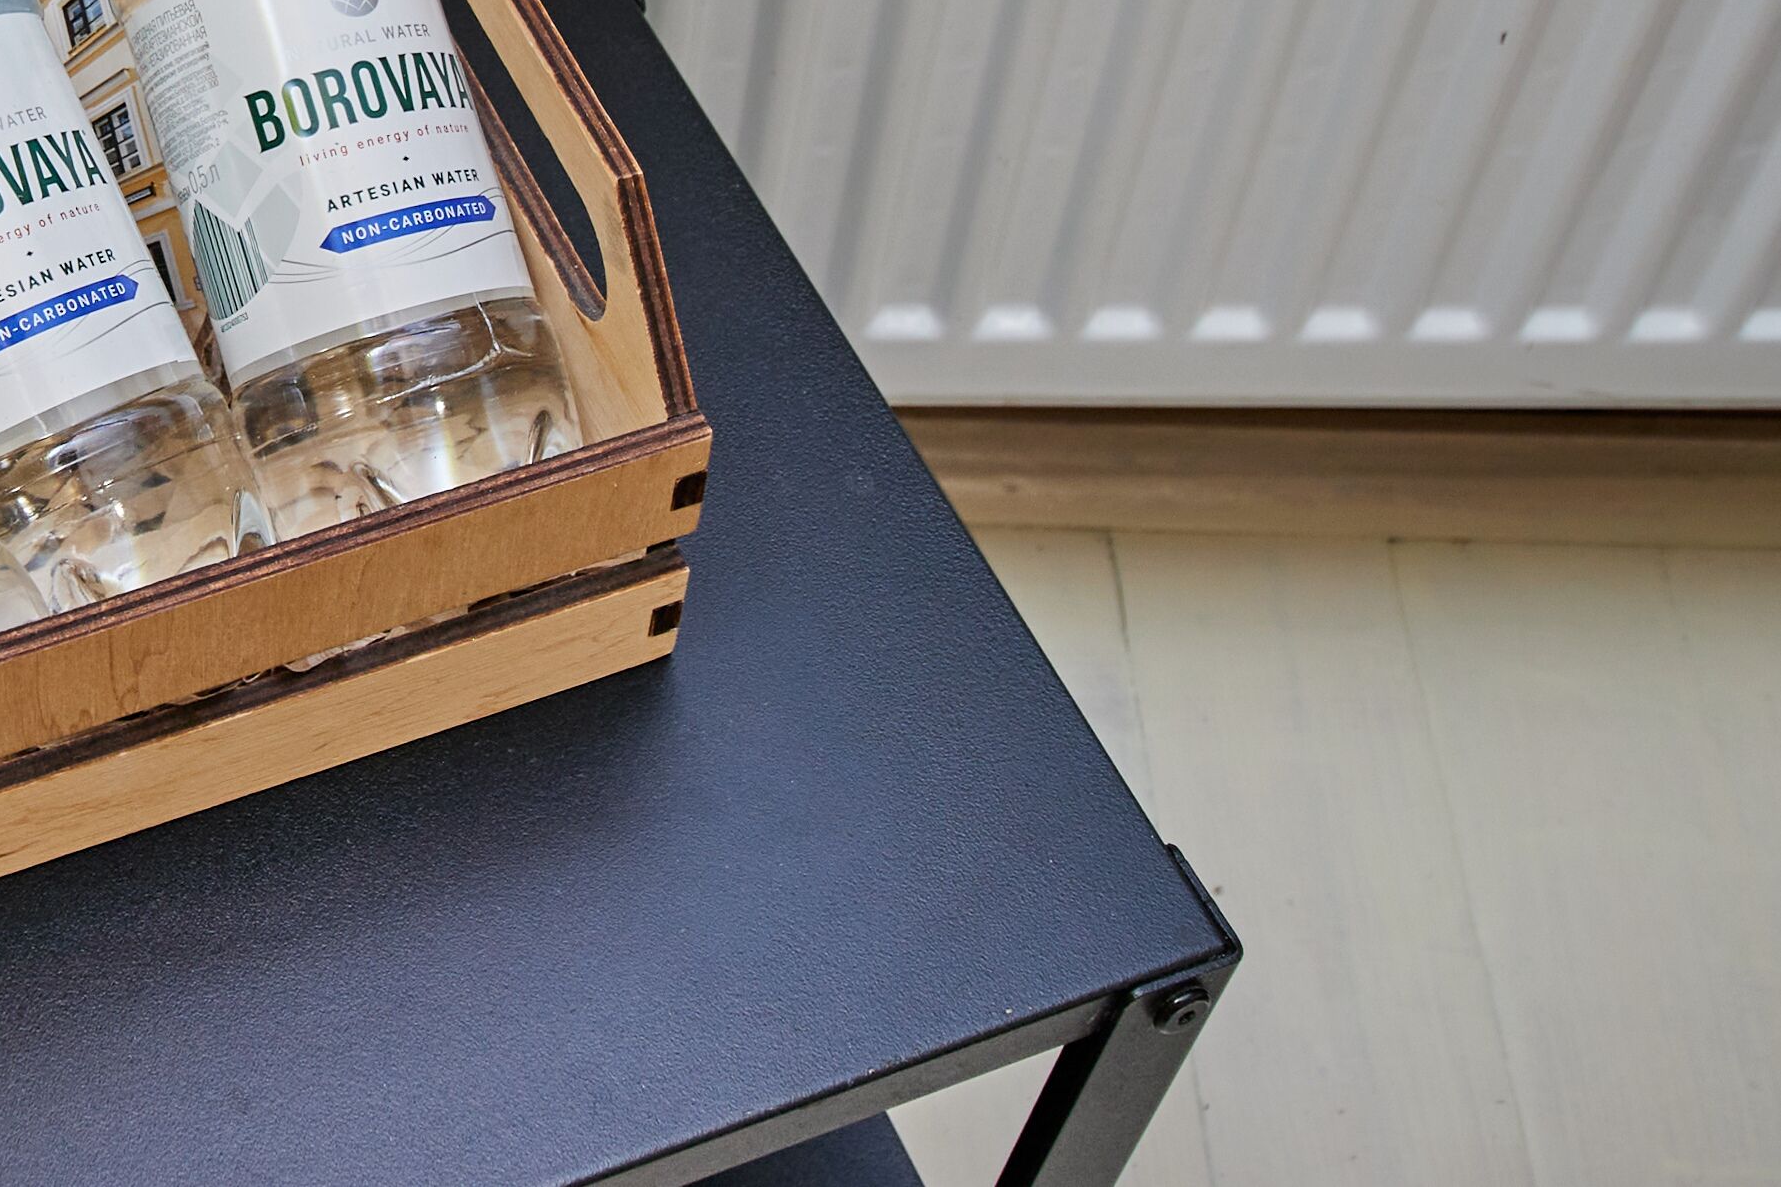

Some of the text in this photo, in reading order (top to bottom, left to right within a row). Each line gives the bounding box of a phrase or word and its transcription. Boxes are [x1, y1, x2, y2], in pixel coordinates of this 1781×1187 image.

[381, 23, 432, 39] WATER
[243, 52, 474, 153] BOROVAYA
[299, 123, 469, 166] living energy of nature
[188, 165, 209, 196] 0,5
[327, 168, 480, 213] ARTESIAN WATER
[39, 214, 54, 228] of
[60, 202, 101, 221] nature
[341, 202, 487, 245] NON-CARBONATED
[60, 248, 116, 276] WATER
